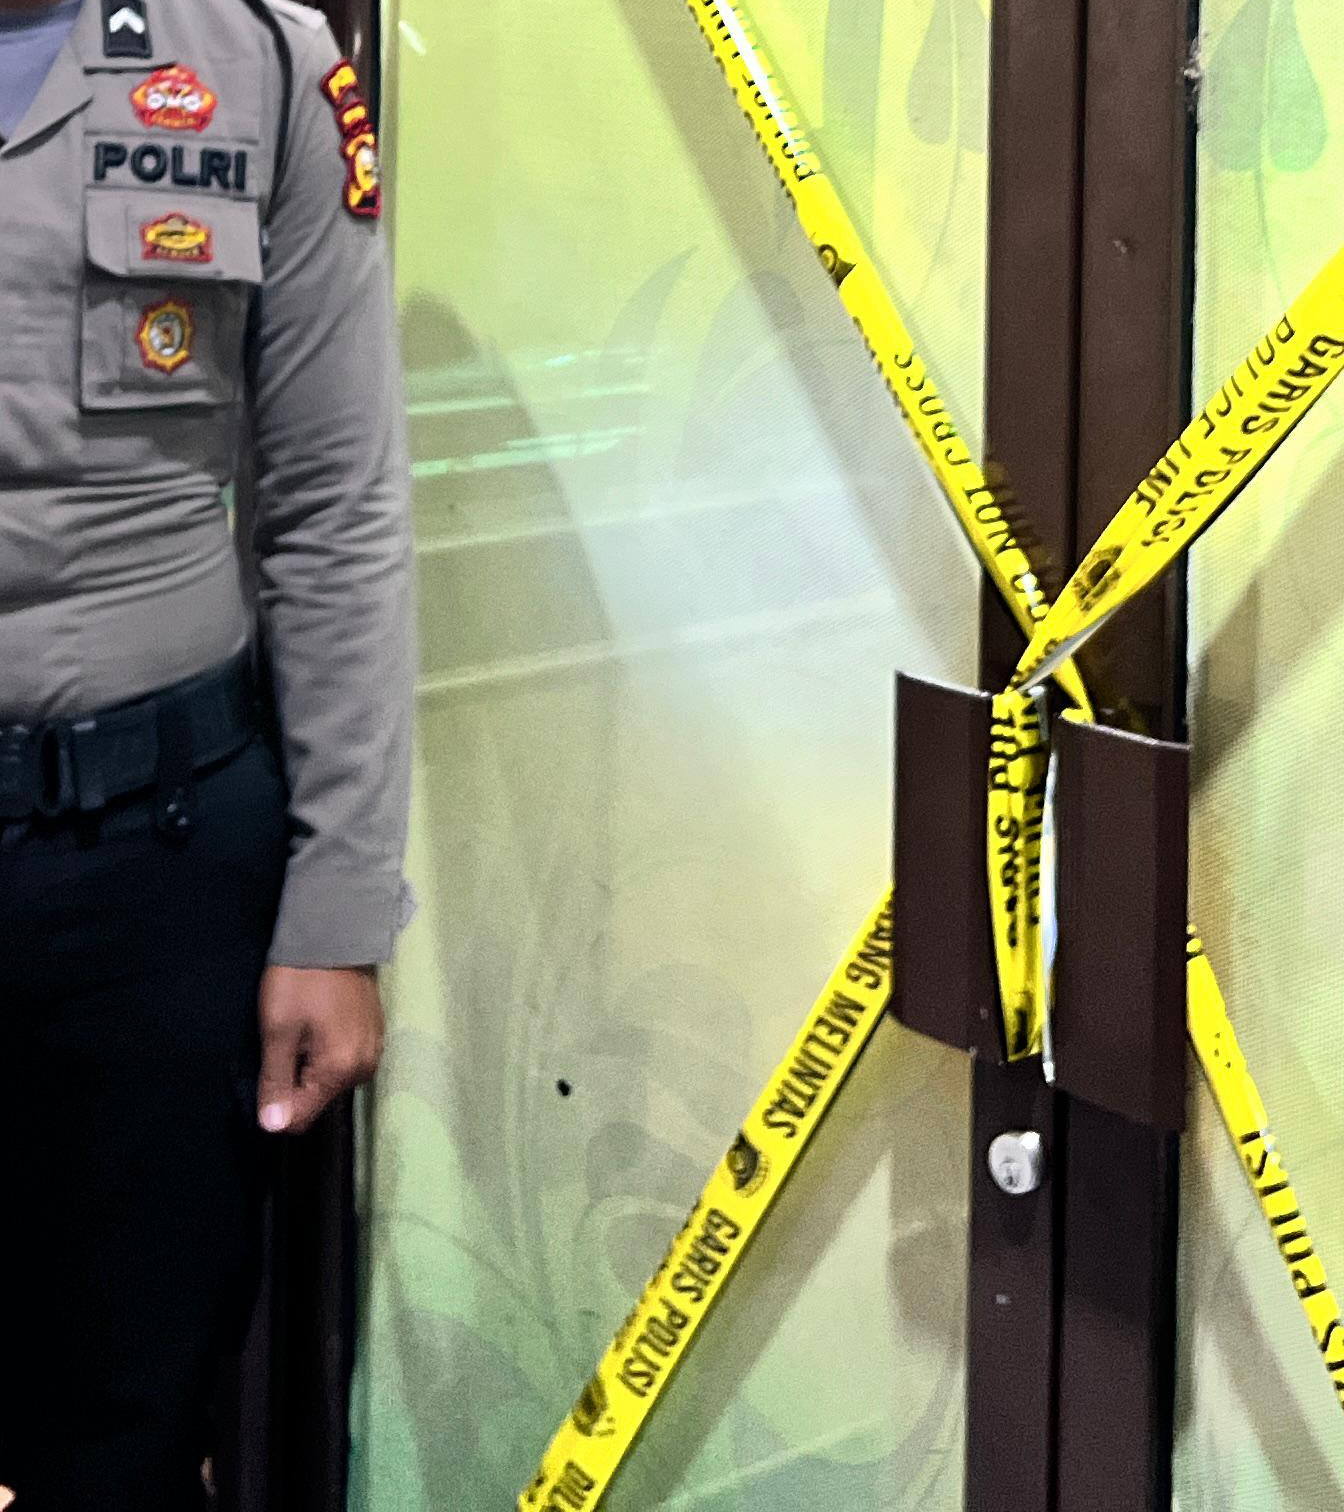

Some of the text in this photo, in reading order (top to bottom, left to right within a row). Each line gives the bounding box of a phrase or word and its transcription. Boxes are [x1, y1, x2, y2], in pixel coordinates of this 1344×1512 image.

[94, 140, 249, 191] POLRI
[760, 988, 867, 1139] MELINTAS
[614, 1207, 743, 1398] GARIS POLISI
